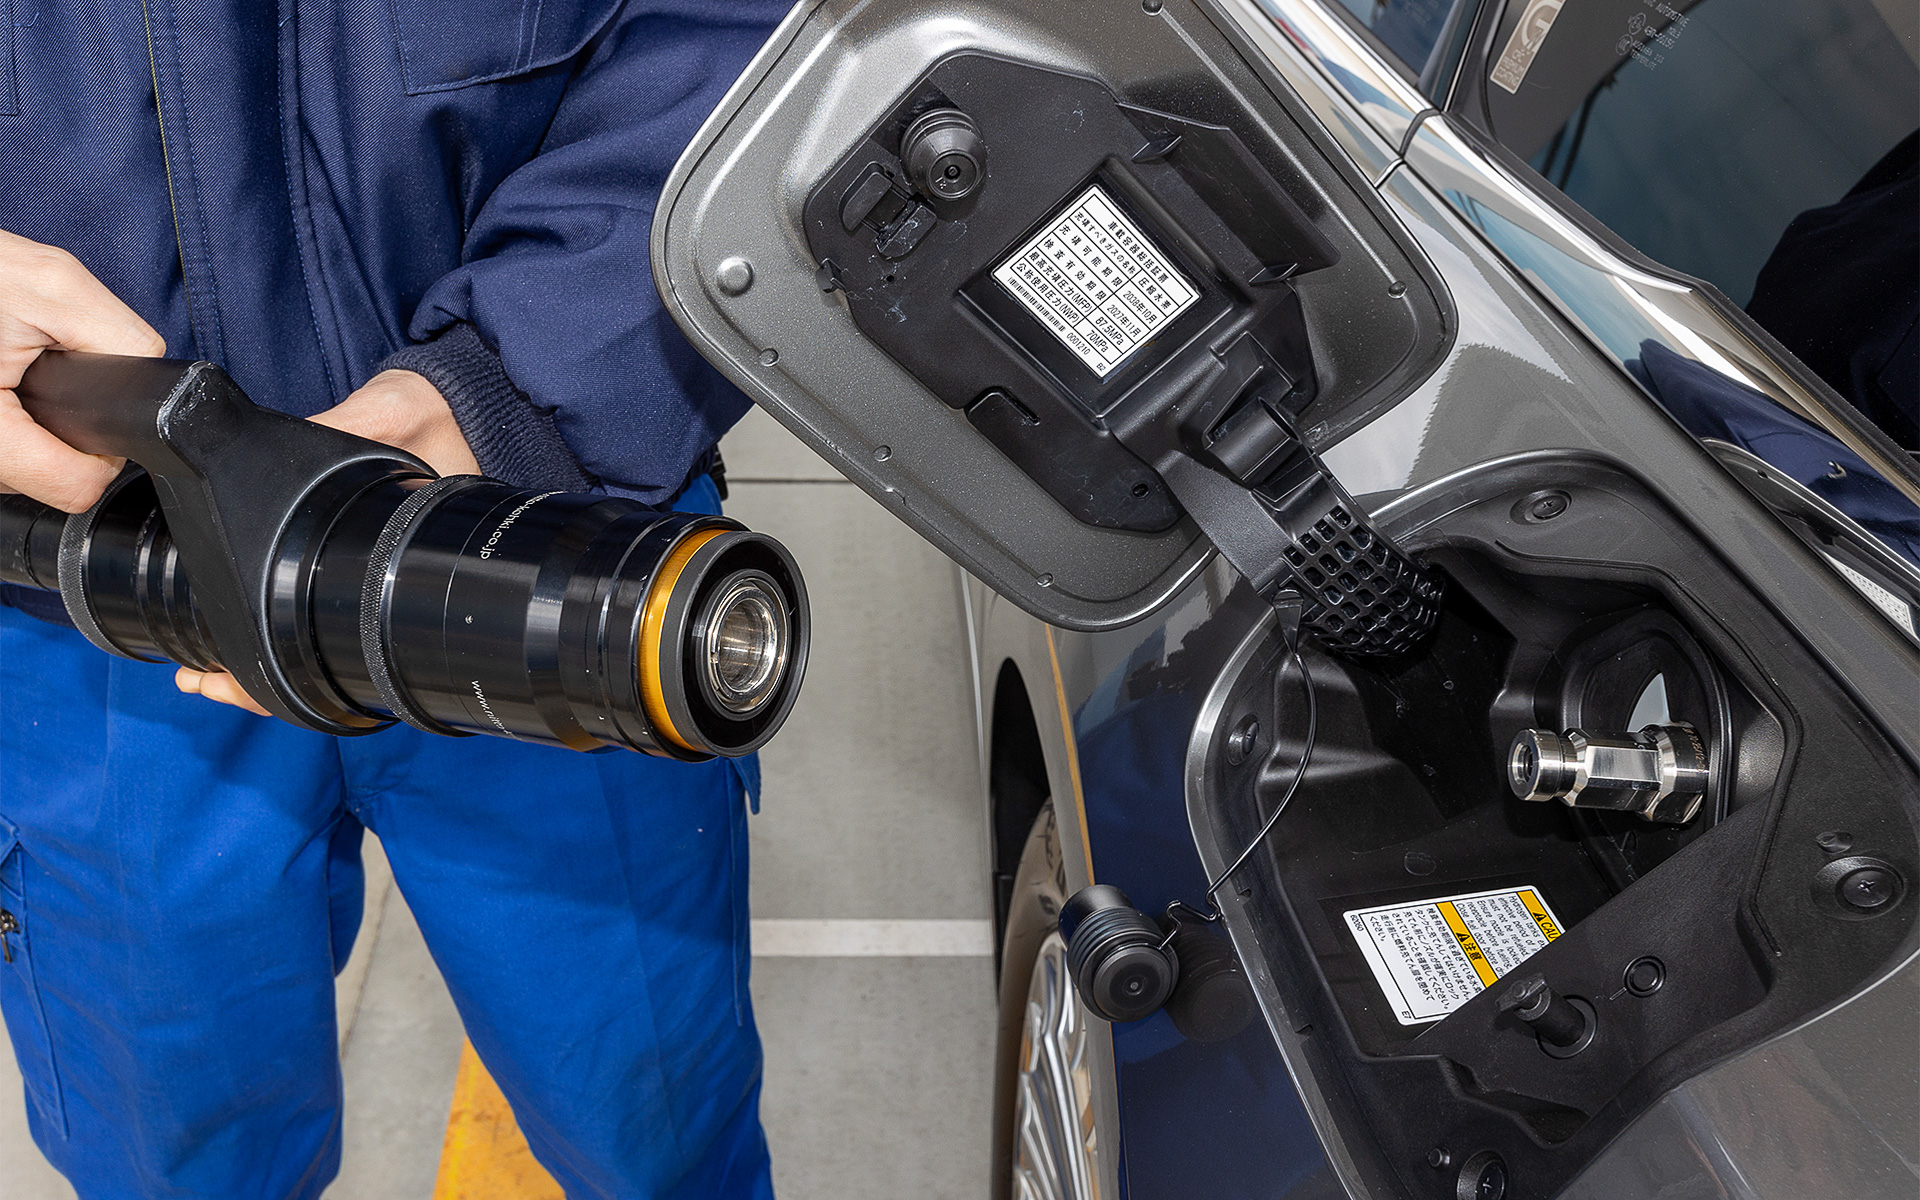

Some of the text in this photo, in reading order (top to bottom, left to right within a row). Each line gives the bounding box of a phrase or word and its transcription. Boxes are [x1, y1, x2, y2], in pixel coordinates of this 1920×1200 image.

[1654, 2, 1690, 27] AUTOMOTIVE
[1074, 211, 1171, 309] 充填すべきガスの名称 圧縮水素
[1107, 220, 1168, 283] 車載容器総括証票
[1043, 238, 1141, 337] 検査有効期限 2027年11月
[1058, 224, 1157, 324] 充填可能期限 2038年10月
[1066, 332, 1090, 355] 0001210
[1086, 329, 1108, 352] 70MPa
[1094, 316, 1124, 345] 87.5MPa
[1369, 915, 1386, 941] ください。
[1466, 901, 1487, 927] receptacle
[1483, 929, 1499, 946] before
[1476, 899, 1492, 917] Ensure
[1489, 919, 1504, 936] nozzle
[1487, 898, 1501, 911] must
[1496, 913, 1508, 923] not
[1497, 897, 1516, 918] effective
[1512, 920, 1530, 937] period
[1508, 895, 1529, 920] Hydrogen
[1525, 921, 1540, 937] tanks
[1455, 902, 1469, 917] Close
[1466, 919, 1479, 930] fuel
[1473, 932, 1486, 944] door
[1482, 946, 1498, 964] before
[1462, 942, 1482, 961] 注意
[1400, 1010, 1411, 1019] E7
